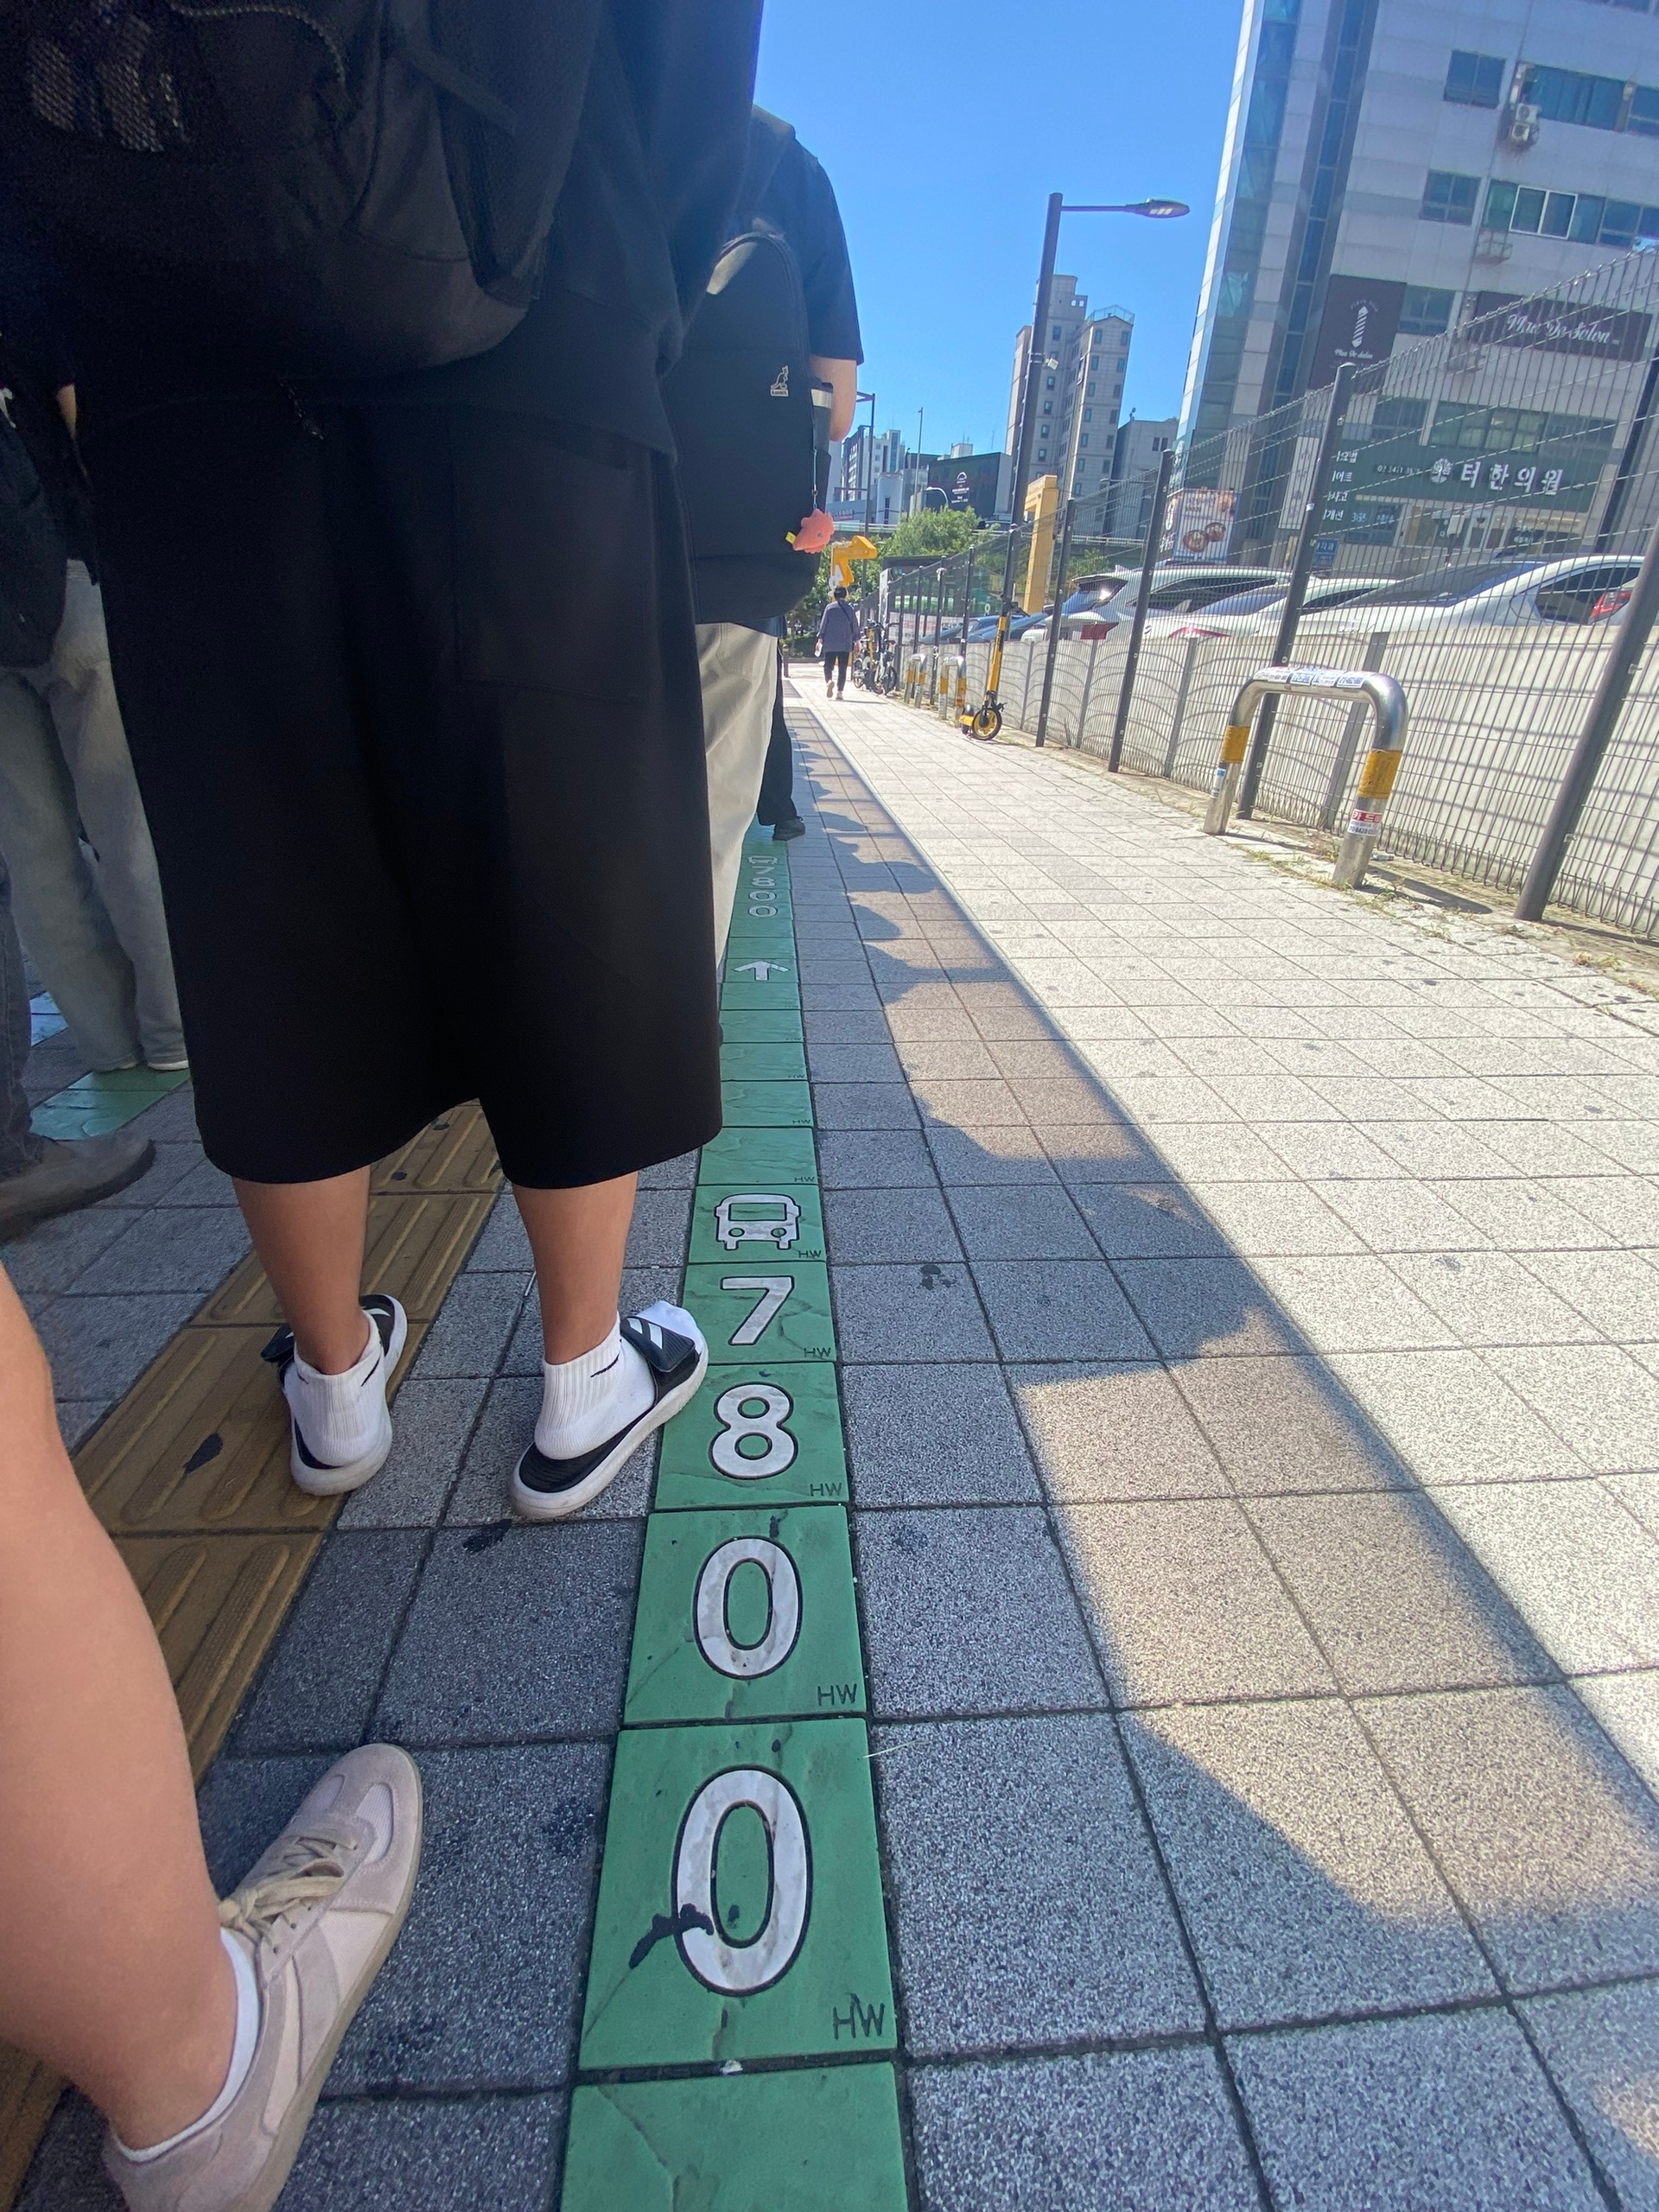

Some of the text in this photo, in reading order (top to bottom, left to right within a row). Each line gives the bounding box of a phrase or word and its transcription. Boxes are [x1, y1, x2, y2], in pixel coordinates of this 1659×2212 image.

[798, 1249, 822, 1260] HW
[804, 1347, 831, 1358] HW
[810, 1483, 842, 1497] HW
[817, 1683, 858, 1707] HW
[832, 1998, 886, 2041] HW
